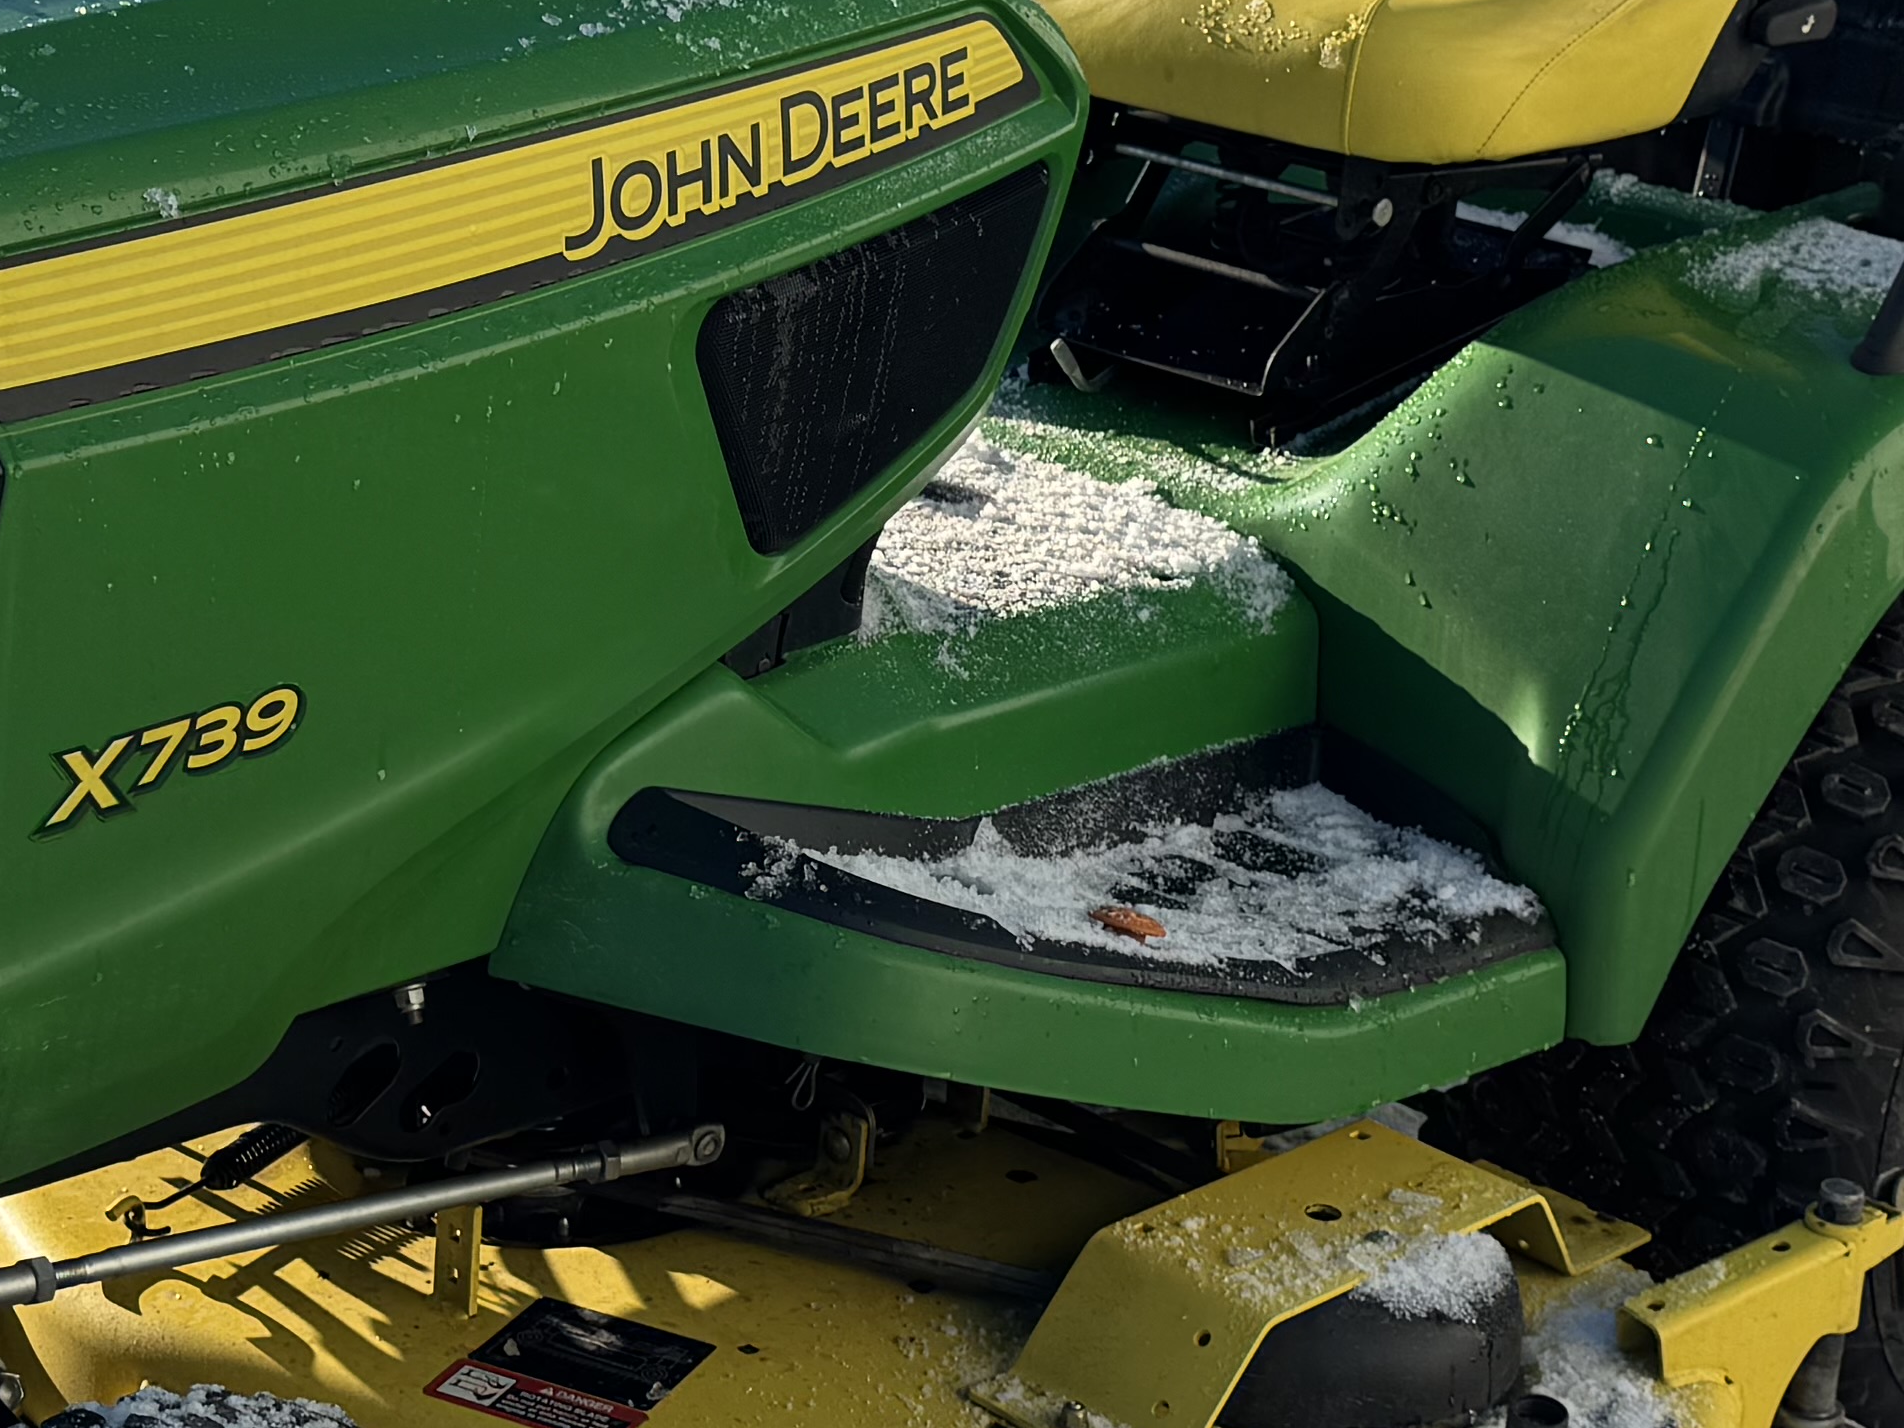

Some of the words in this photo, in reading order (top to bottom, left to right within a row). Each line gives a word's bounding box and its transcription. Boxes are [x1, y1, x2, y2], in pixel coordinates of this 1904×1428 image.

[564, 122, 763, 253] JOHN
[780, 45, 972, 178] DEERE
[40, 684, 303, 832] X739
[519, 1391, 573, 1412] ROTATING
[574, 1407, 611, 1423] BLADE
[555, 1390, 615, 1414] DANGER
